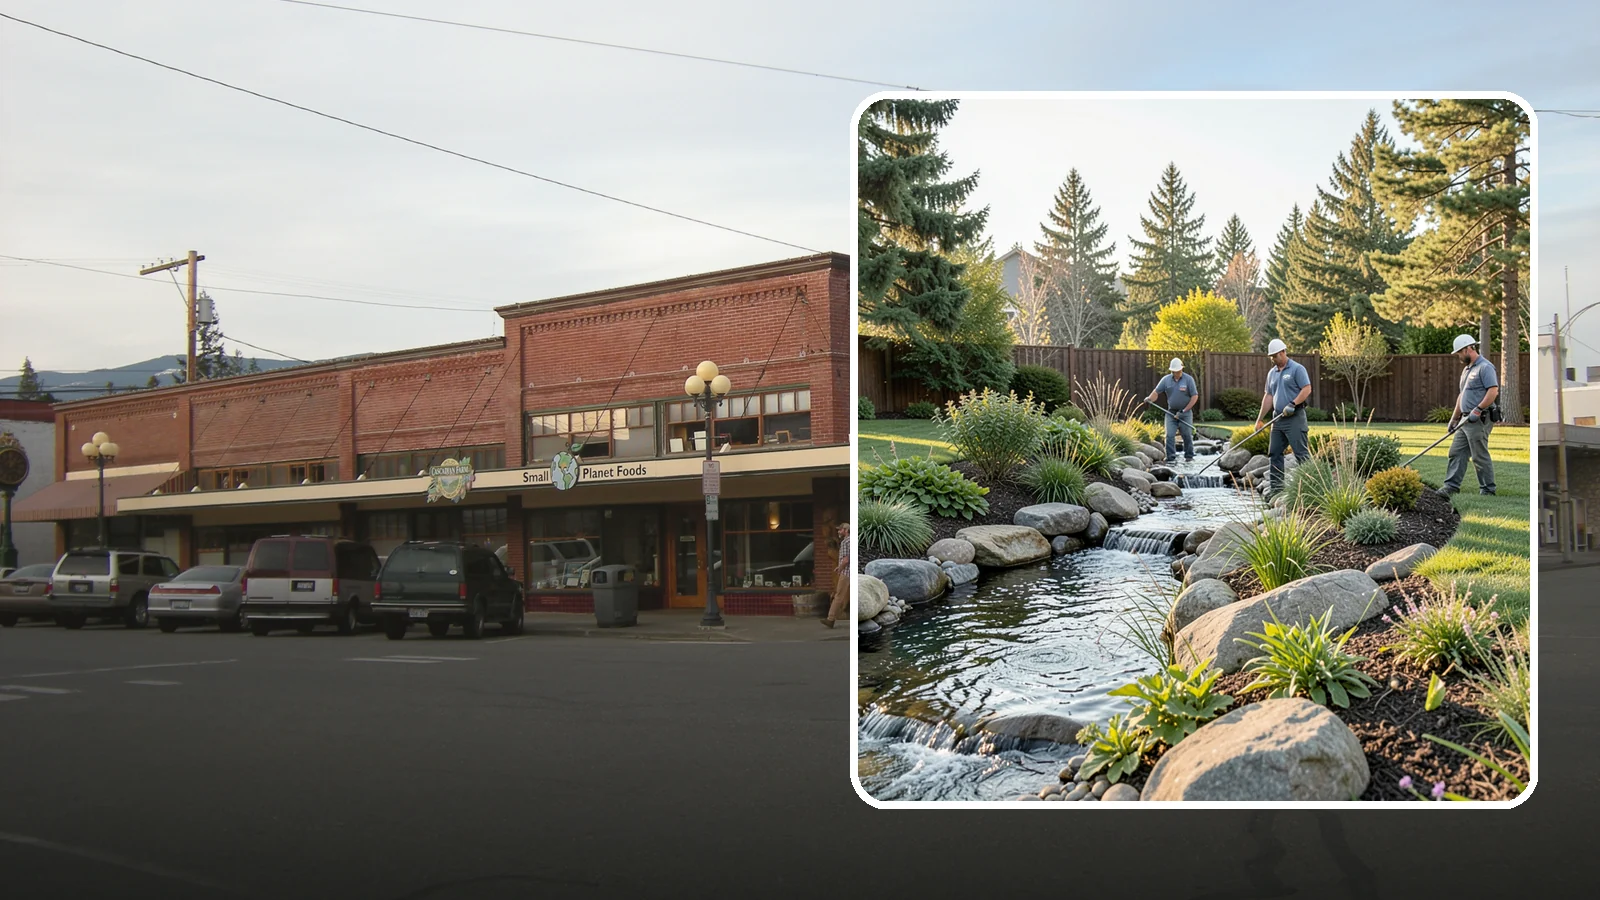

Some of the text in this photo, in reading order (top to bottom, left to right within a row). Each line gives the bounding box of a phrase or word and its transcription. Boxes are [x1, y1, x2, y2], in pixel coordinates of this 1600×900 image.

[523, 464, 647, 483] Small Planet Foods
